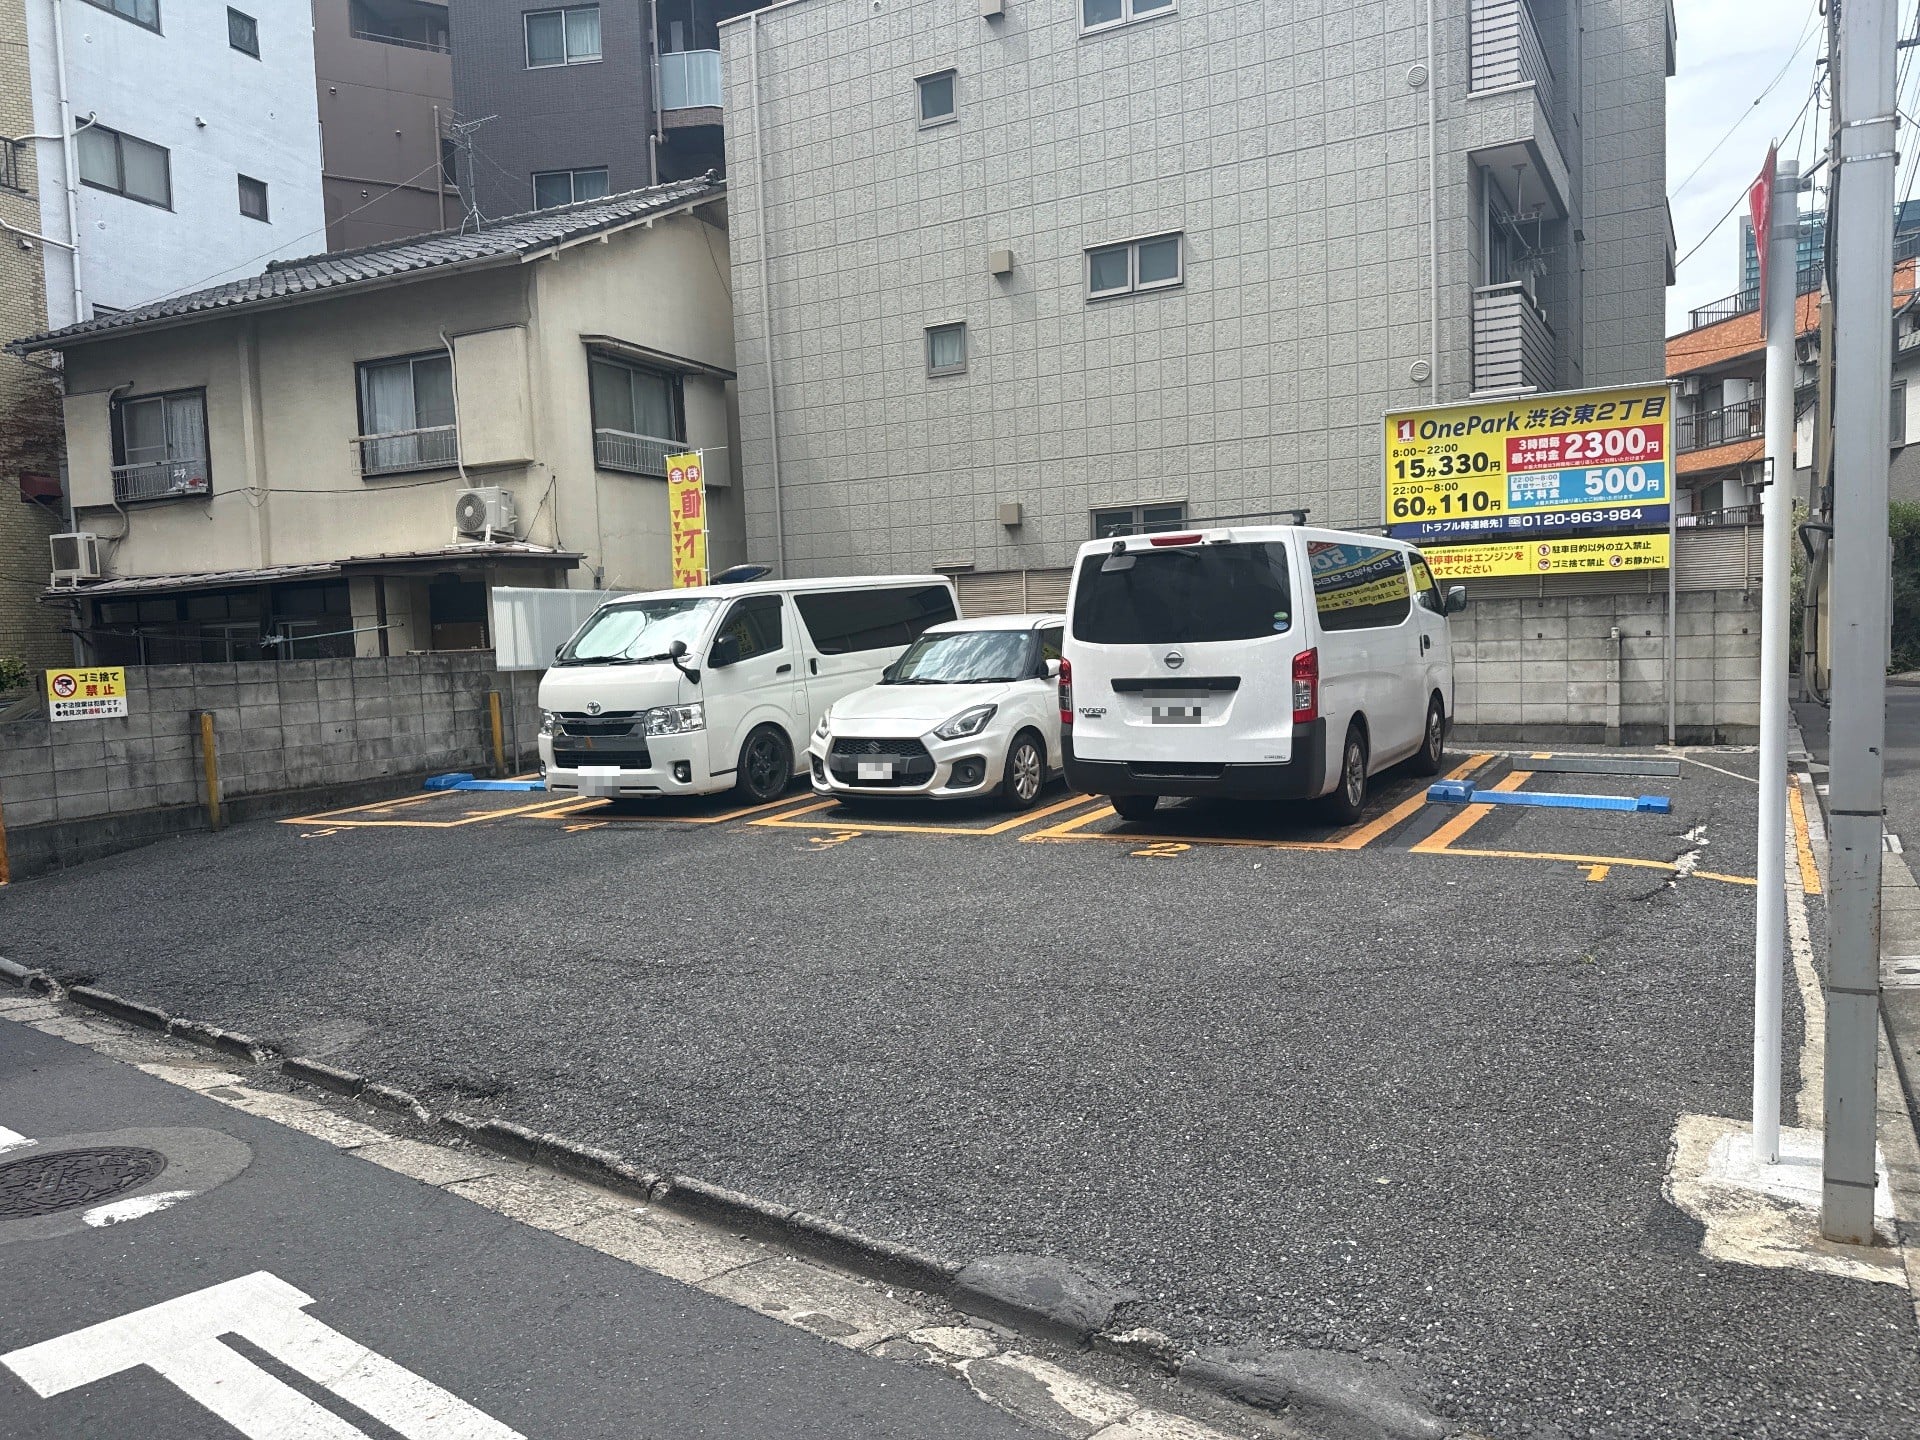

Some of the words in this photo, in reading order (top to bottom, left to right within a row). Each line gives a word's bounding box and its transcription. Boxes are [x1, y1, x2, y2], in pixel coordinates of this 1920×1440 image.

[1420, 411, 1521, 440] OnePark
[1524, 397, 1666, 429] 渋谷東2丁目
[1519, 437, 1560, 450] 3時間毎
[1565, 428, 1660, 459] 2300円
[1512, 450, 1560, 464] 最大料金
[1585, 466, 1660, 495] 500円
[1512, 488, 1560, 502] 最大料金
[1523, 508, 1643, 527] 0120-963-984
[1551, 541, 1652, 553] 駐車目的以外の立入禁止
[1432, 564, 1492, 576] めてください
[1552, 558, 1605, 568] ゴミ捨て禁止
[79, 672, 119, 683] ゴミ捨て
[86, 684, 115, 696] 禁止
[1130, 842, 1192, 858] 2
[1577, 864, 1612, 882] 1
